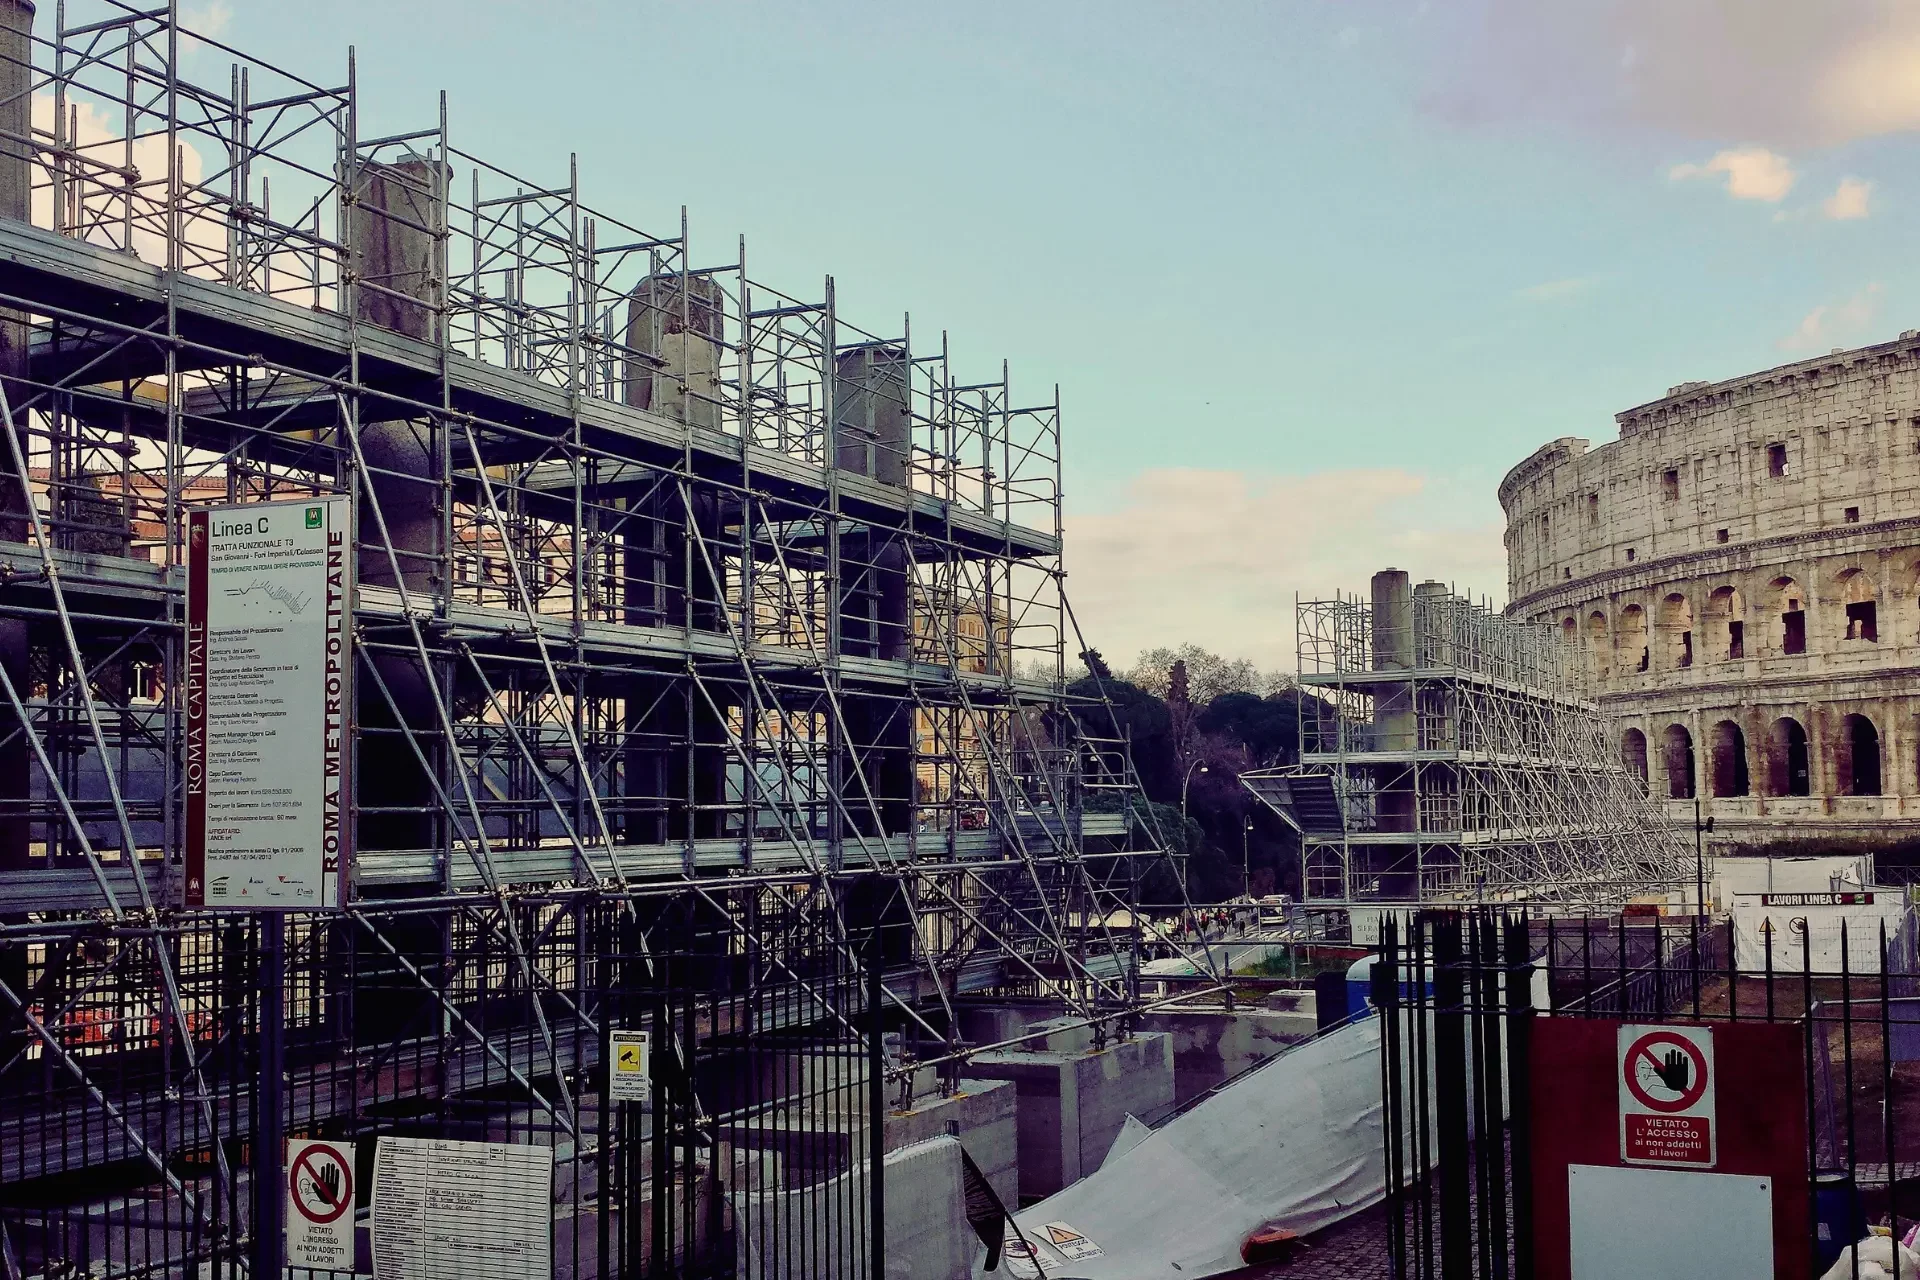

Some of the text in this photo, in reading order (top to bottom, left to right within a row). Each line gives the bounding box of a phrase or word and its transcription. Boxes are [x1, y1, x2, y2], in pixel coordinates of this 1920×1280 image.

[212, 517, 269, 537] Linea C
[211, 538, 294, 552] TRATTA FUNZIONALE T3
[224, 552, 249, 560] Giovanni
[324, 531, 342, 873] ROMA METROPOLITANE
[188, 621, 203, 795] ROMA CAPITALE
[1768, 894, 1842, 905] LAVORI LINEA C
[1646, 1118, 1689, 1128] VIETATO
[1646, 1128, 1699, 1139] ACCESSO
[1666, 1140, 1702, 1149] addetti
[1660, 1149, 1688, 1158] lavori
[308, 1226, 333, 1235] VIETATO
[302, 1236, 338, 1244] L'INGRESSO
[318, 1247, 344, 1255] ADDETTI
[314, 1256, 335, 1264] LAVORI
